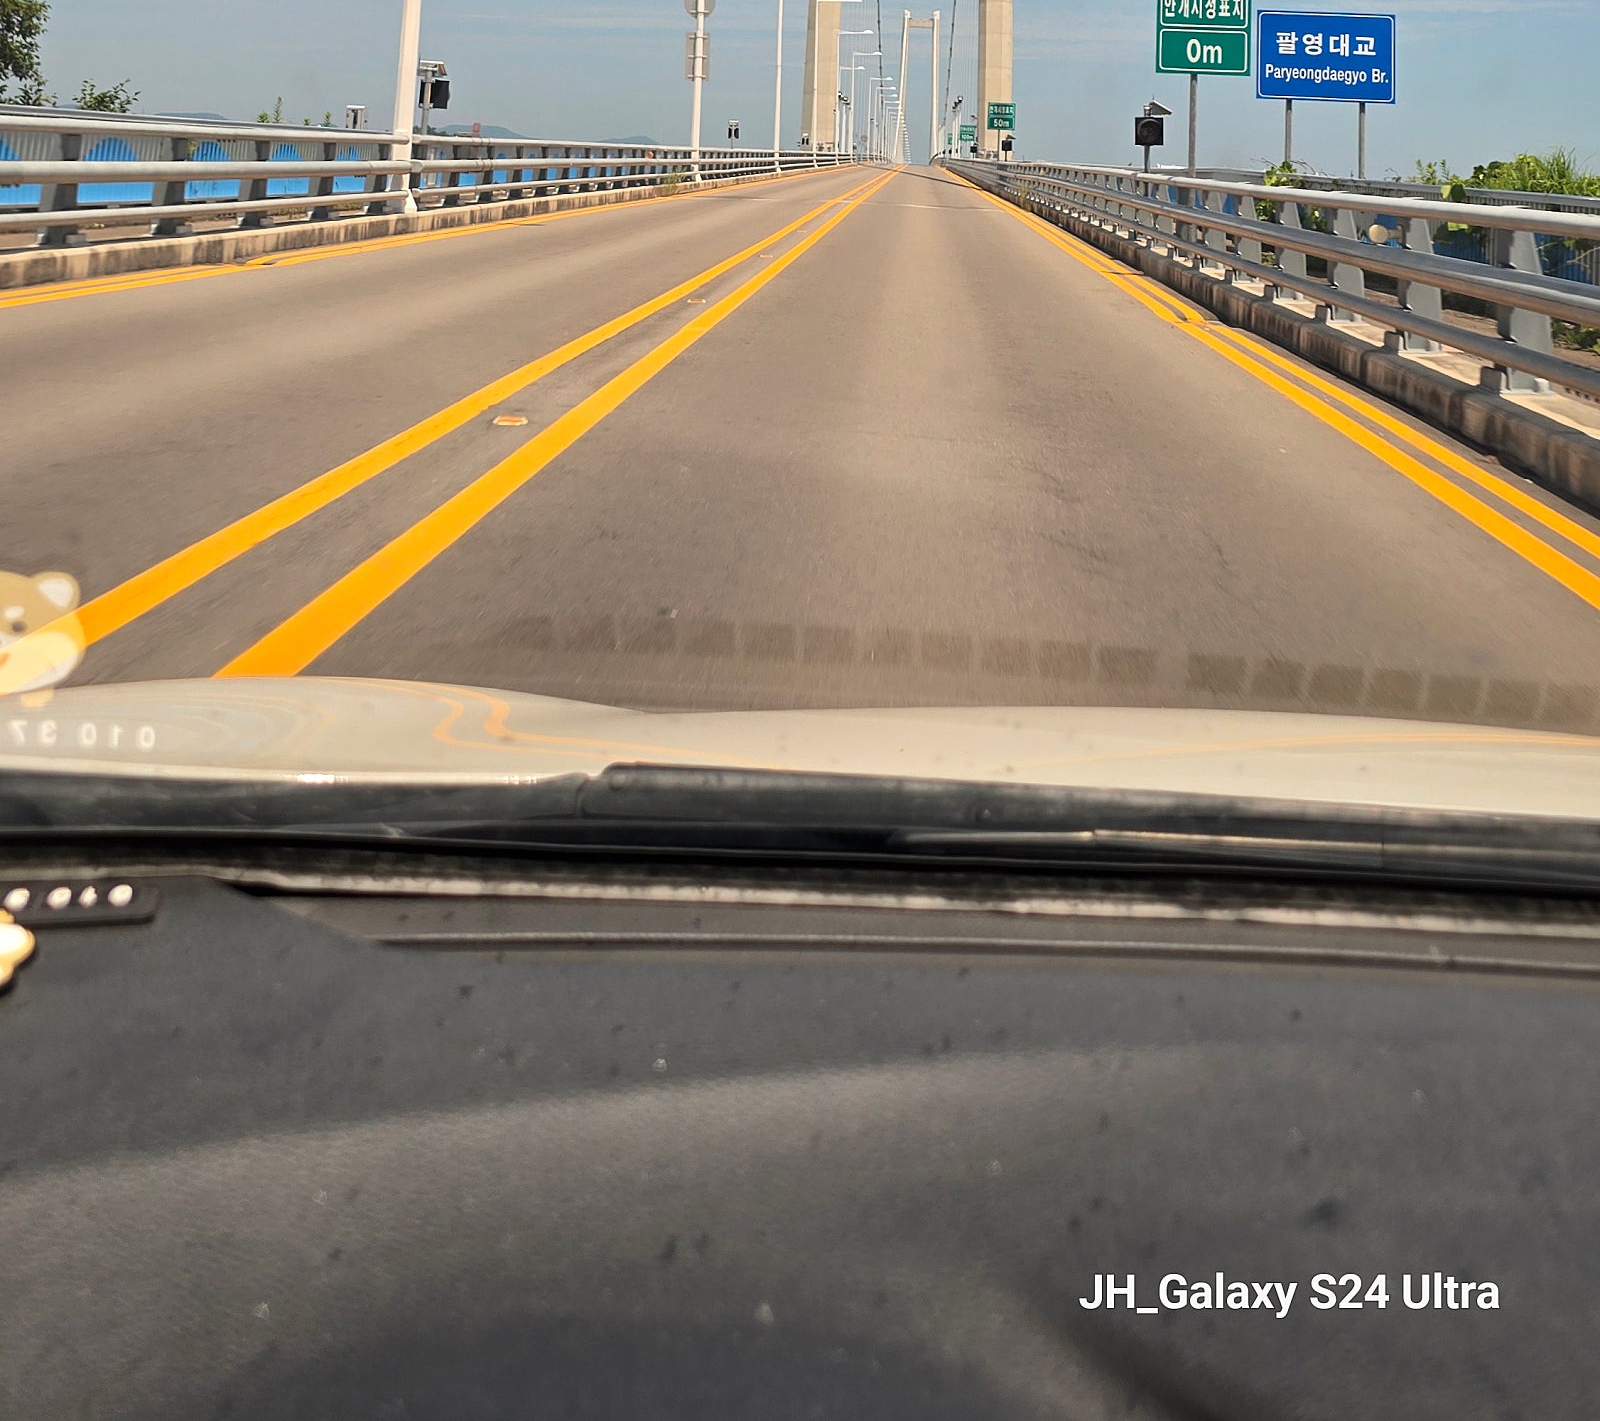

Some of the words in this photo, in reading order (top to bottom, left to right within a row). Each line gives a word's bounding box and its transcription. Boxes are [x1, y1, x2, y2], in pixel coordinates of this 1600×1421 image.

[1186, 38, 1223, 64] 0m
[1275, 31, 1377, 57] 팔영대교
[1265, 63, 1367, 86] Paryeongdaegyo
[1371, 68, 1389, 84] Br.
[993, 119, 1010, 127] 50m
